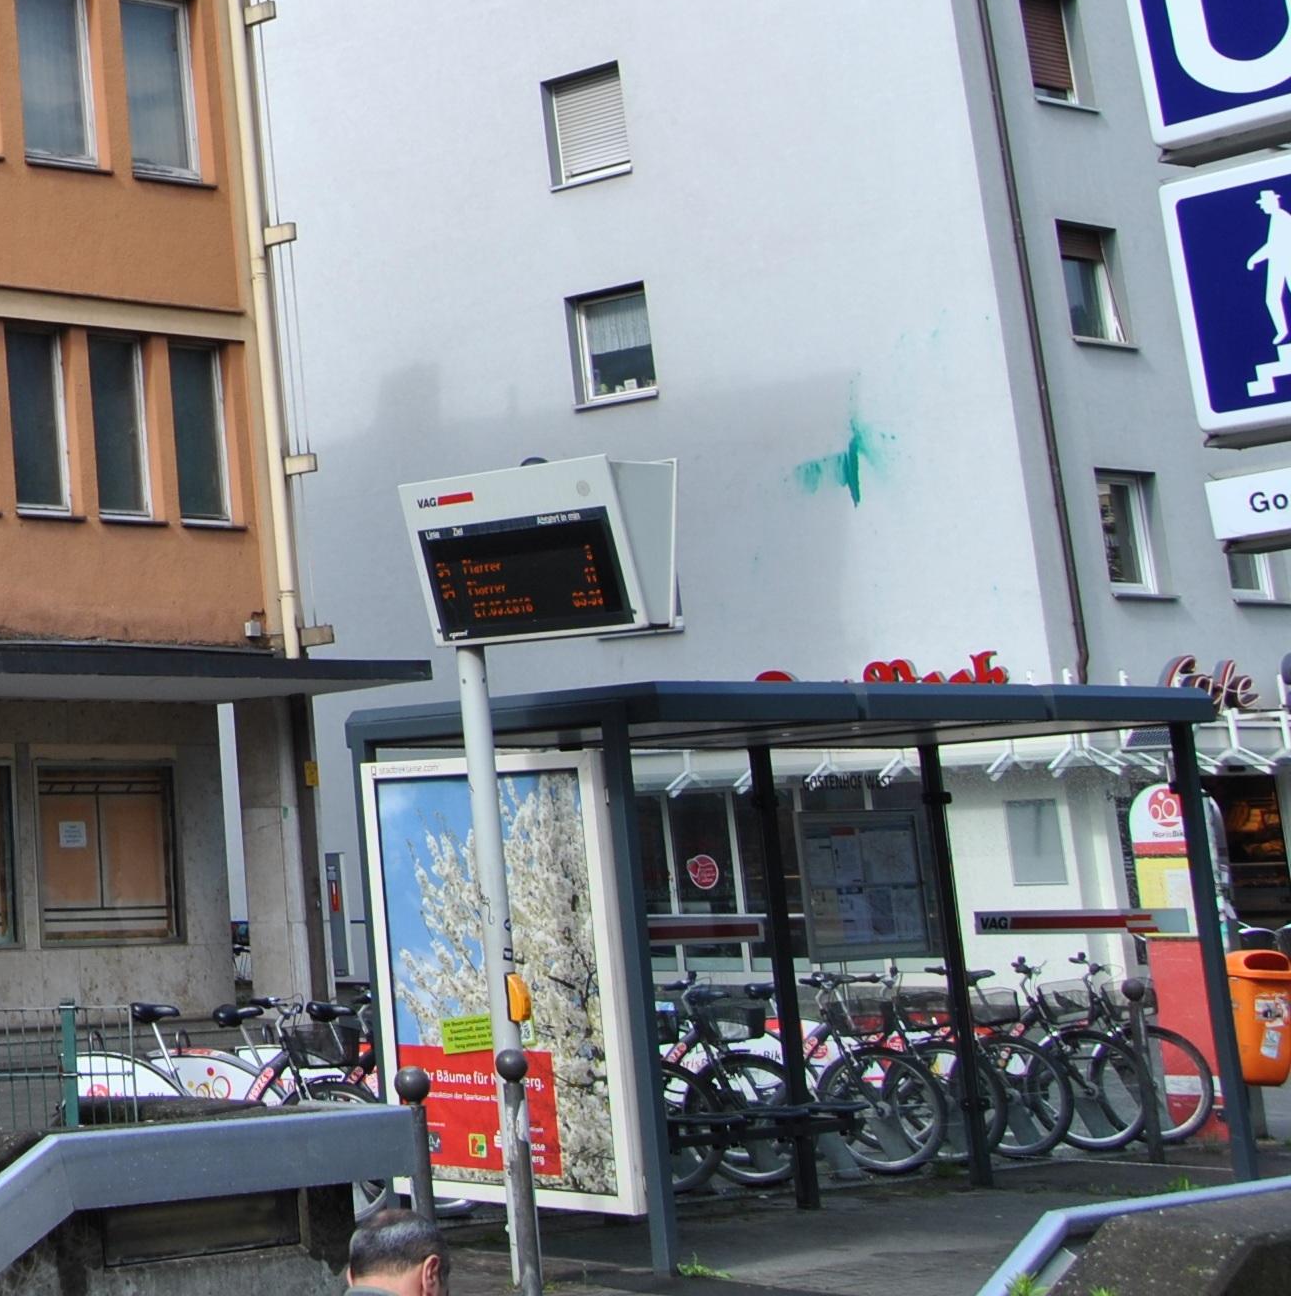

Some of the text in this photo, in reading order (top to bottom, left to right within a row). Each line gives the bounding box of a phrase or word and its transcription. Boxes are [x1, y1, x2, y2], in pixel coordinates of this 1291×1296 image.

[417, 497, 437, 509] VAG
[980, 916, 1009, 930] VAG
[436, 1069, 472, 1084] Bäume
[472, 1071, 489, 1086] für
